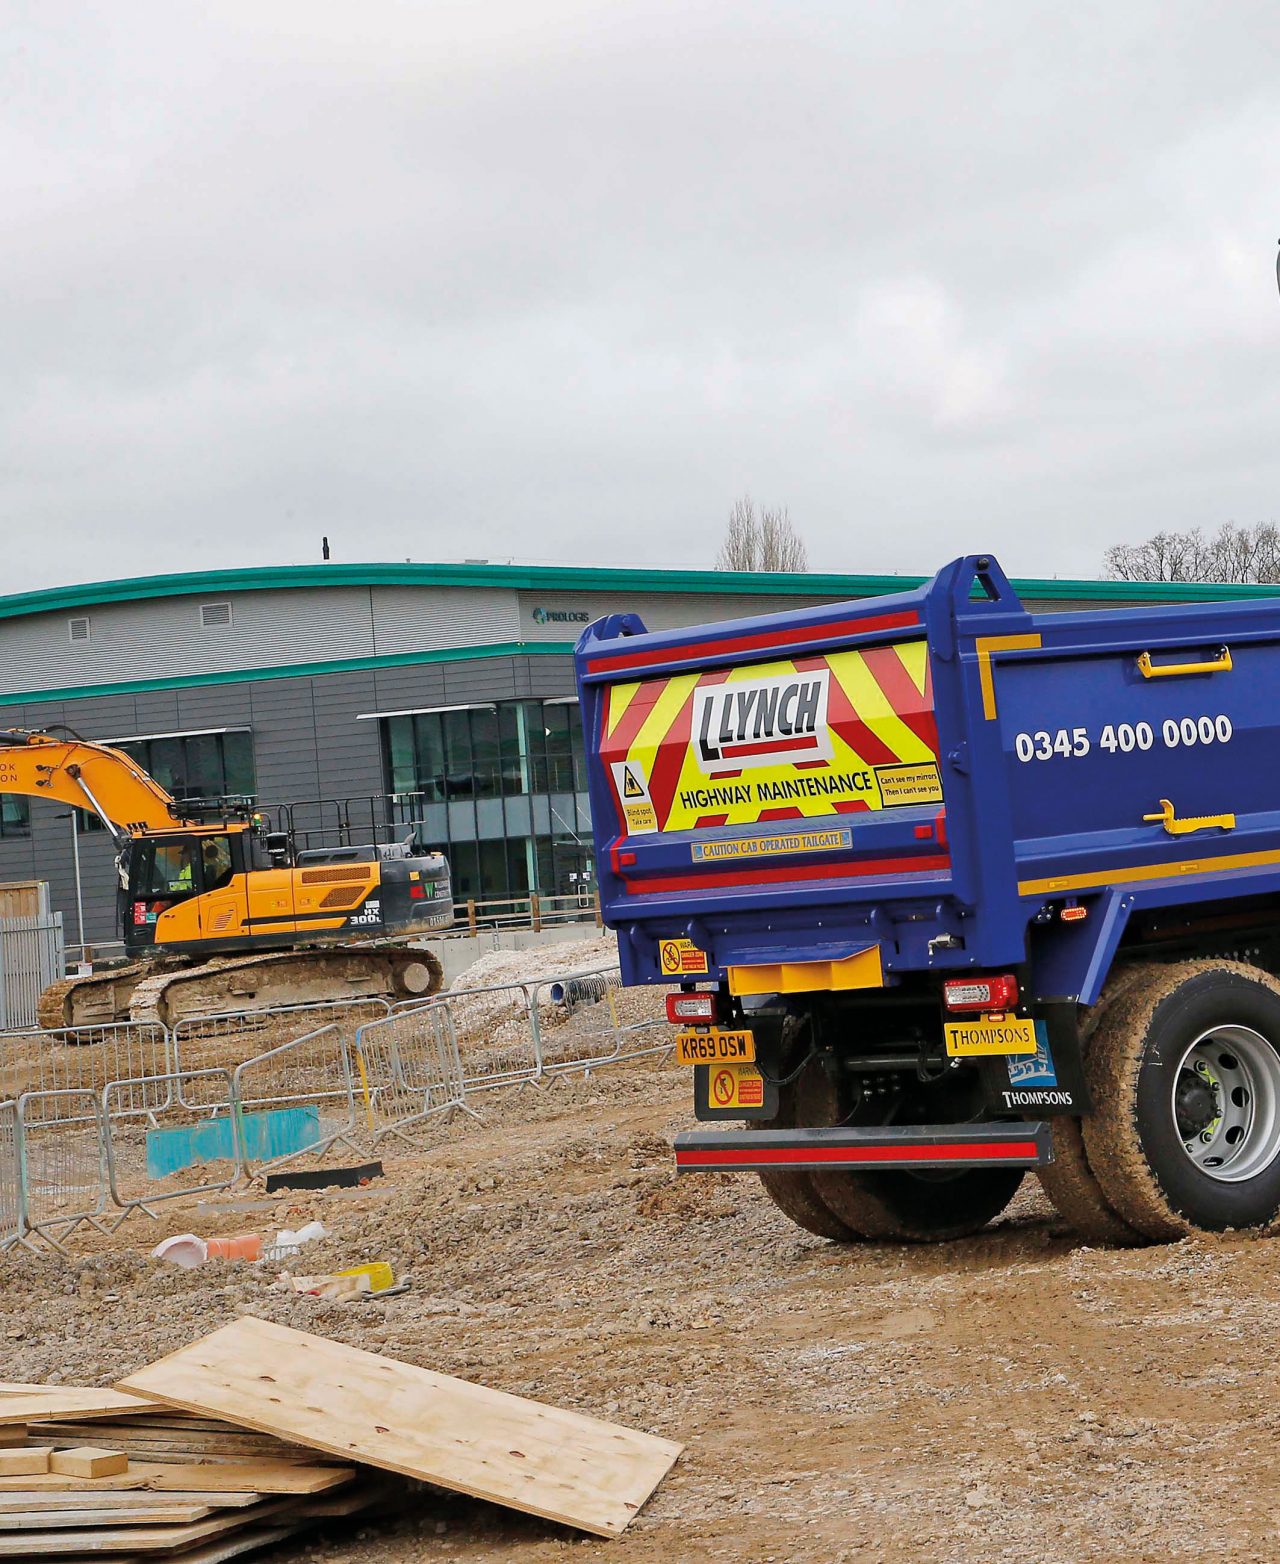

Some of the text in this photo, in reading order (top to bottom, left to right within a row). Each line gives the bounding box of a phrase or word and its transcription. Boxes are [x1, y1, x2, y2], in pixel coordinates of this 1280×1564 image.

[547, 611, 589, 622] PROLOGIS
[1015, 714, 1233, 762] 0345 400 0000
[906, 775, 916, 783] my
[916, 773, 938, 781] mirrors
[680, 771, 873, 809] HIGHWAY MAINTENANCE
[885, 788, 900, 796] Then
[904, 786, 917, 794] can't
[928, 785, 940, 793] you
[627, 808, 640, 816] Blind
[703, 832, 840, 857] CAUTION CAB OPERATED TAILGATE
[364, 908, 380, 916] HX
[950, 1027, 1030, 1049] THOMPSONS
[681, 1035, 746, 1059] KR69 OSW
[1002, 1091, 1073, 1108] THOMPSONS
